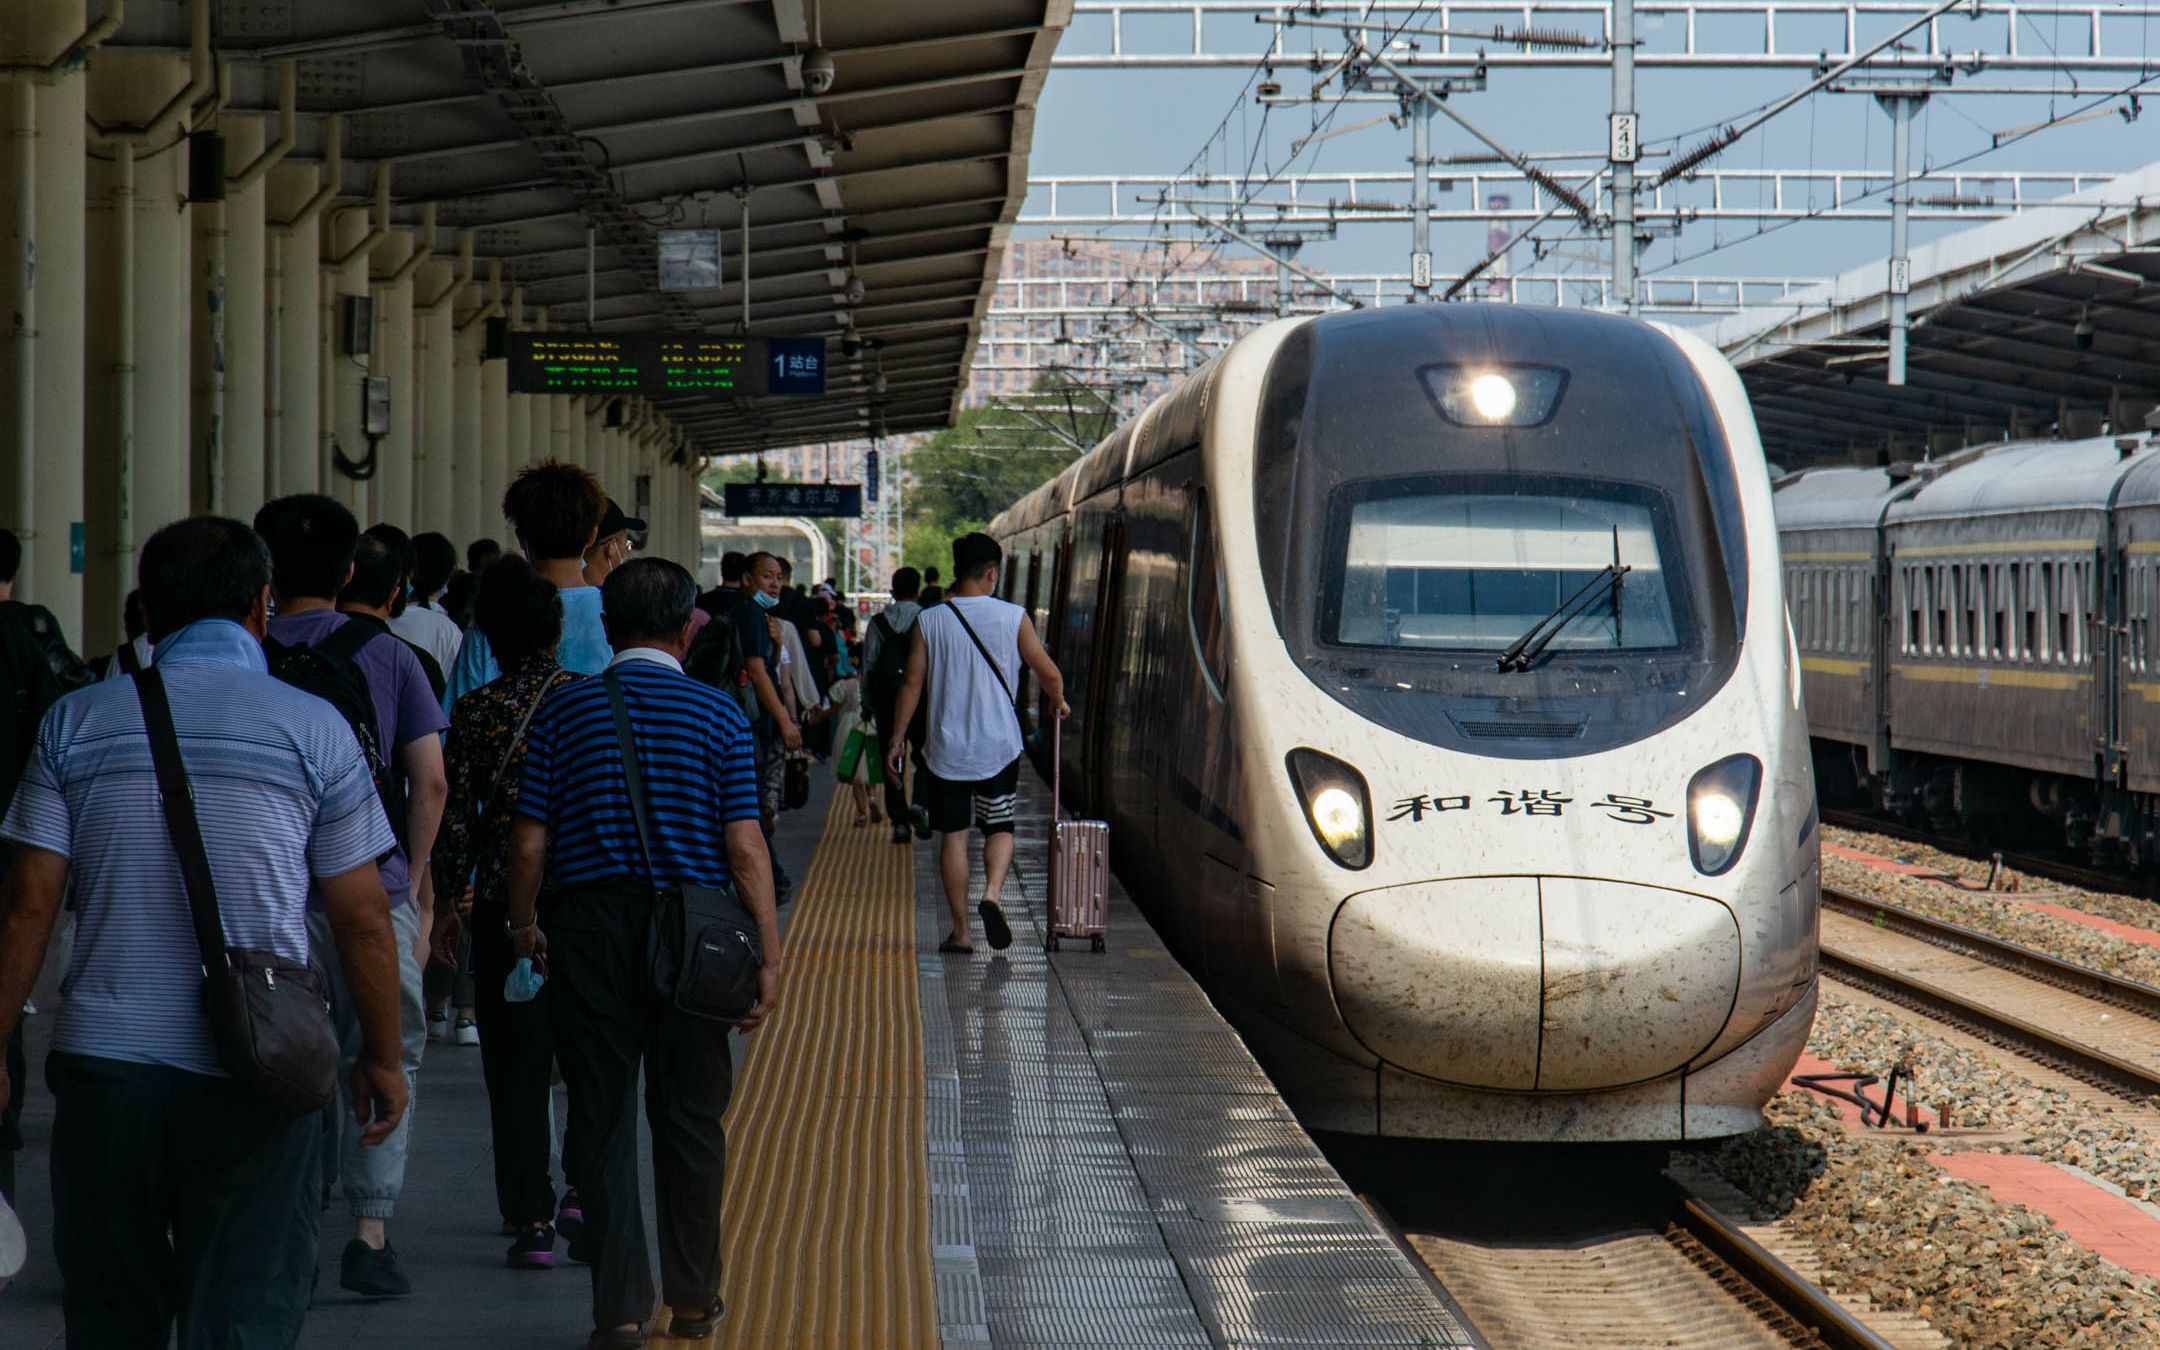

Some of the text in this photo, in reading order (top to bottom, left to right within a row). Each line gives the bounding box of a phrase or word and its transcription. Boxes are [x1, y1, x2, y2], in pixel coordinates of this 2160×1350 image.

[1618, 117, 1630, 158] 243
[773, 353, 818, 378] 1 站台
[1386, 790, 1675, 825] 和谐号
